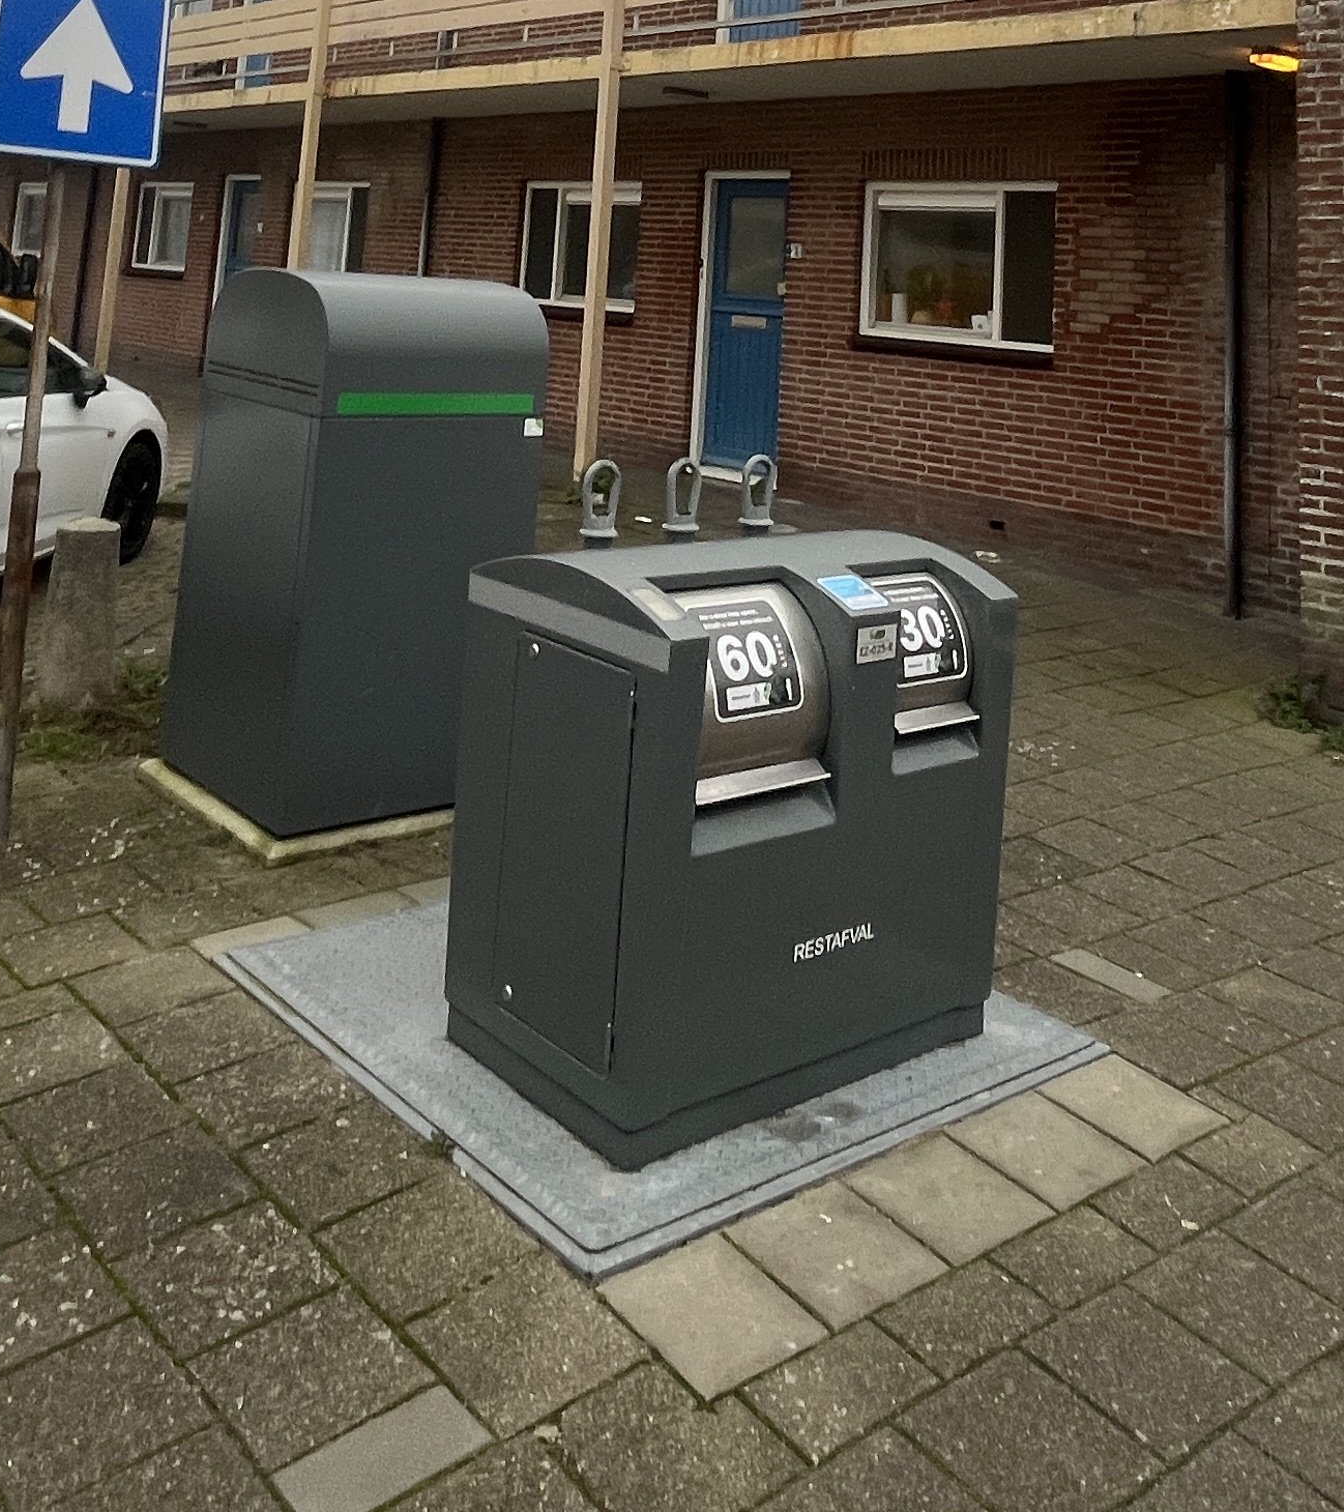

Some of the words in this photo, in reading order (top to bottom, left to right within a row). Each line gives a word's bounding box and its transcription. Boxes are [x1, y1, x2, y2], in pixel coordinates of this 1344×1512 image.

[900, 606, 945, 652] 30
[717, 631, 777, 682] 60
[793, 922, 874, 963] RESTAFVAL
